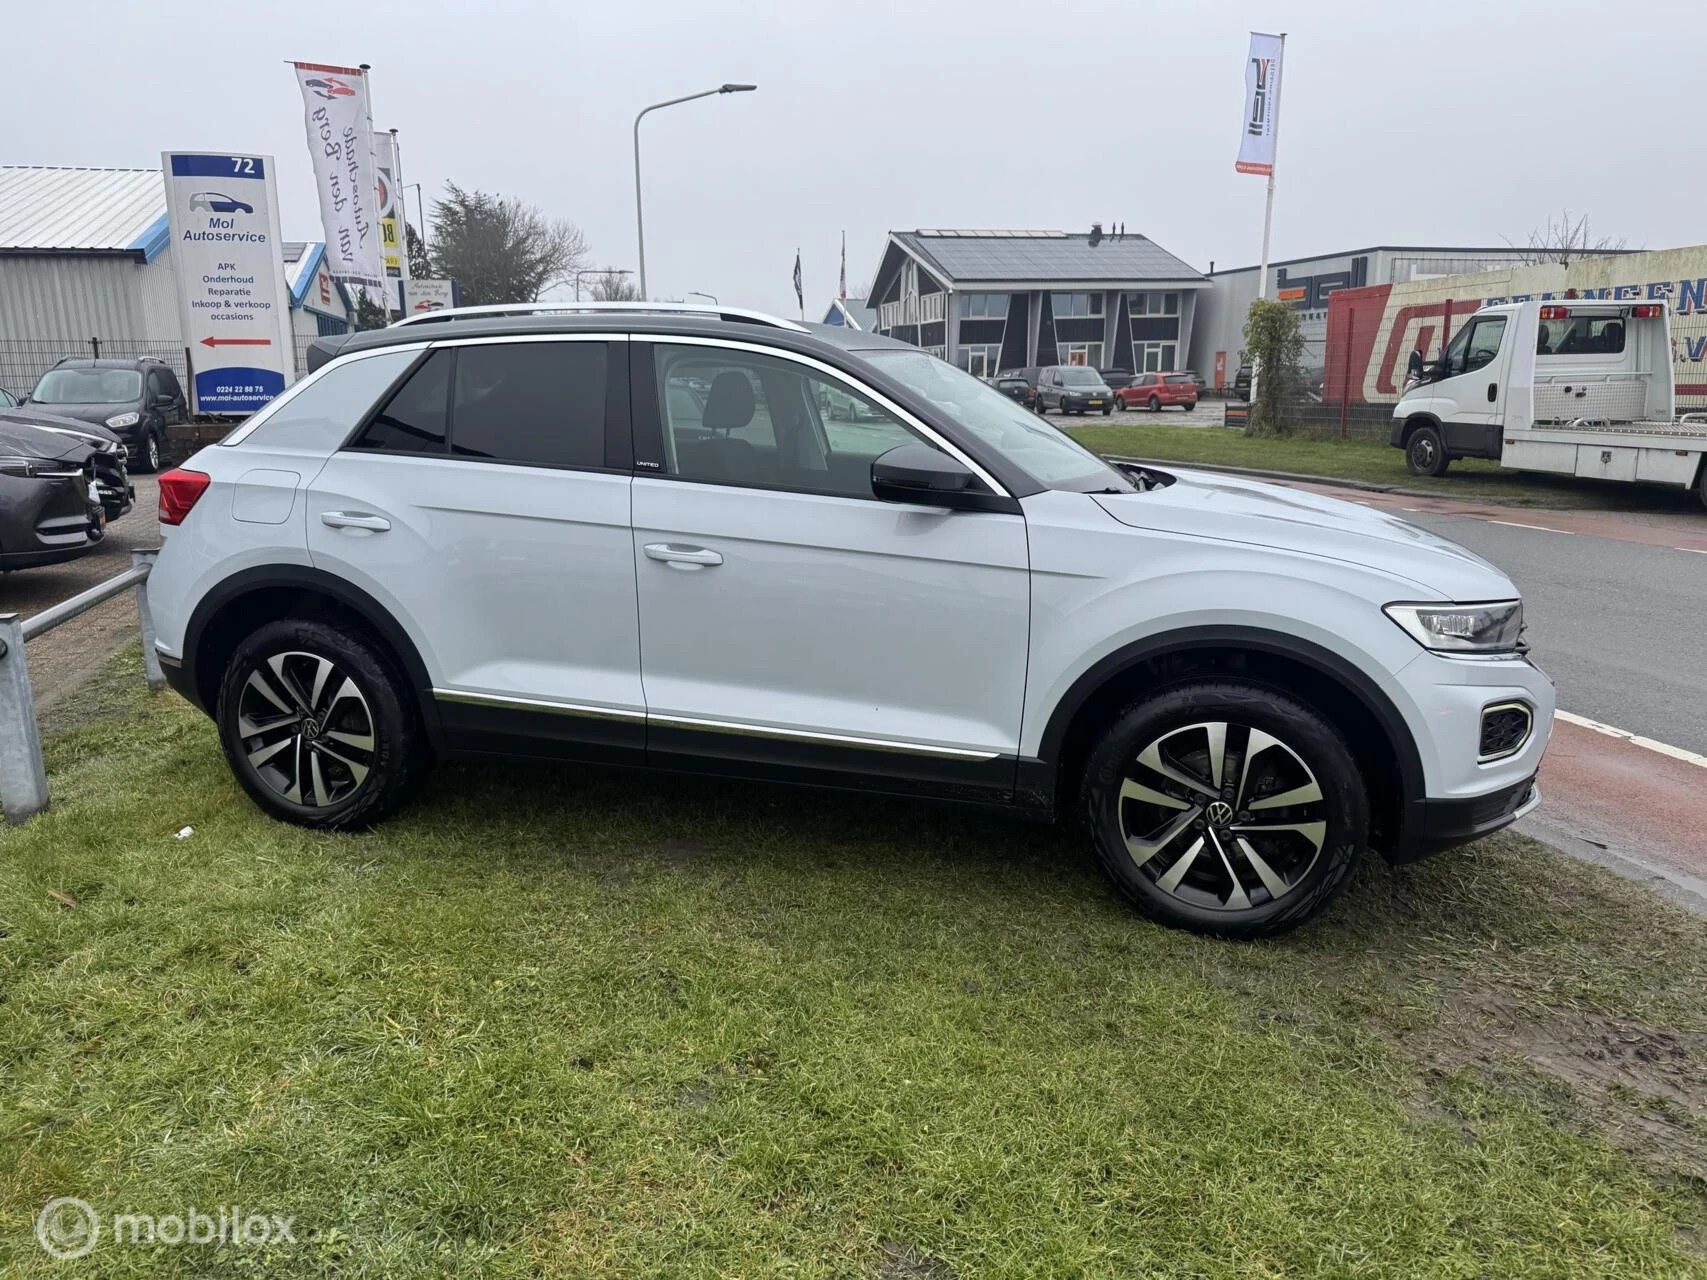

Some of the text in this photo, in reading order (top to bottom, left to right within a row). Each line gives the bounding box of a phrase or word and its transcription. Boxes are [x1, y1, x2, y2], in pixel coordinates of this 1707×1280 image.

[231, 158, 255, 174] 72
[208, 217, 234, 229] Mol
[182, 229, 266, 243] Autoservice
[217, 263, 236, 271] APK
[202, 275, 254, 284] Onderhoud
[208, 287, 251, 296] Reparatie
[192, 300, 271, 310] Inkoop & verkoop
[211, 312, 254, 321] occasions
